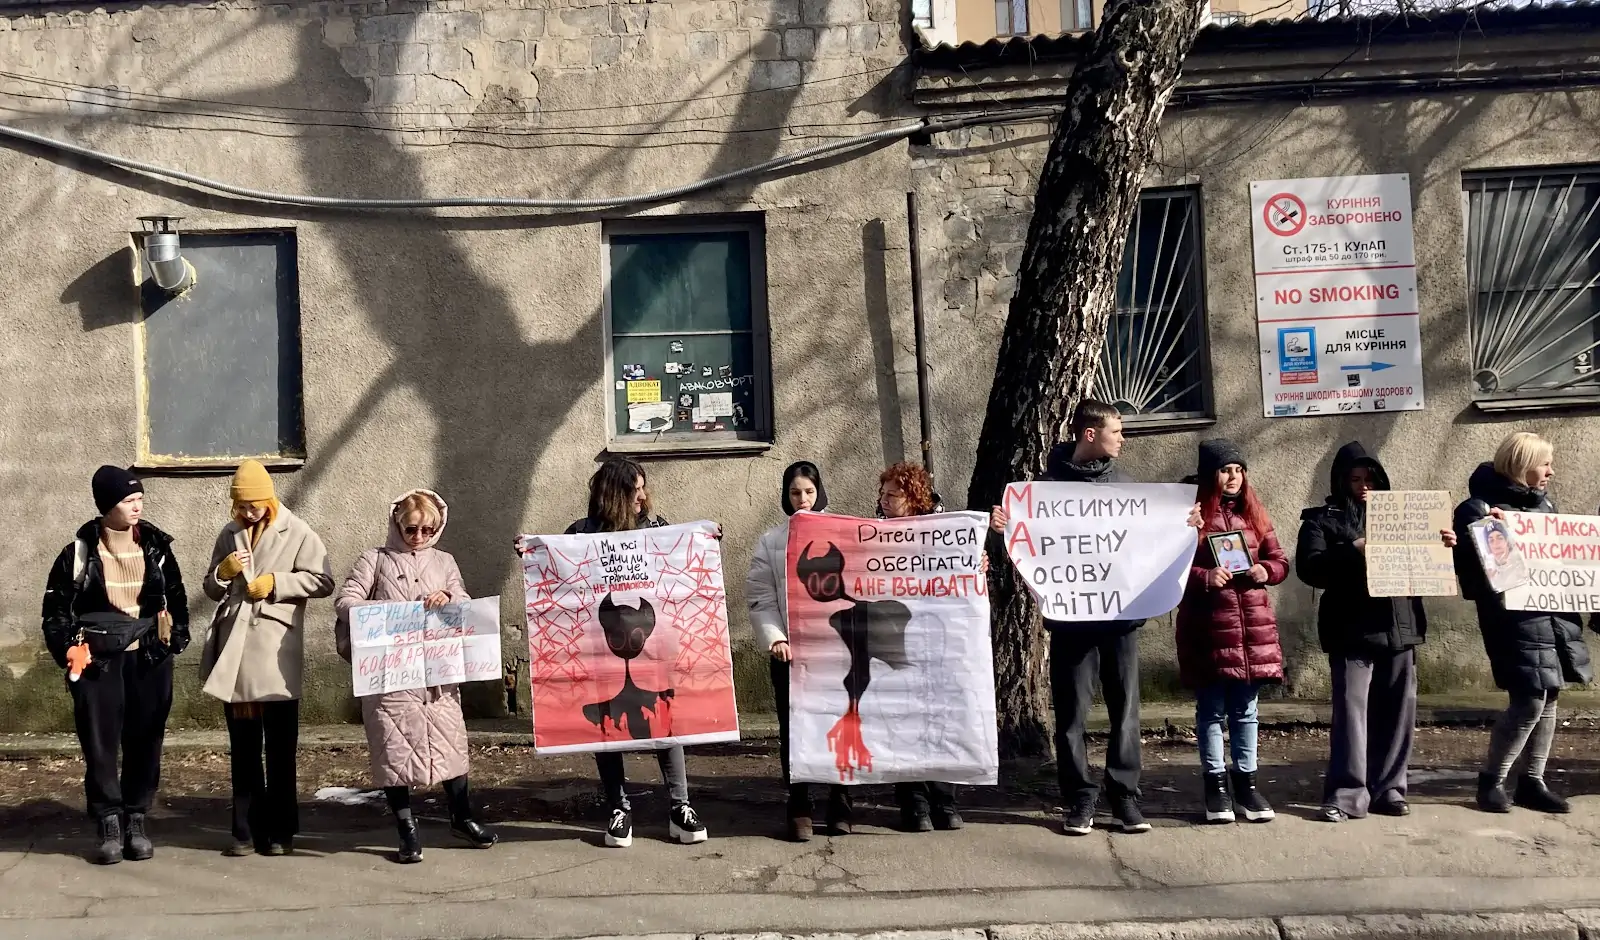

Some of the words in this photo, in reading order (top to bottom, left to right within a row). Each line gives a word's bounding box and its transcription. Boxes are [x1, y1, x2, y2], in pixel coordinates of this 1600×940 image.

[1327, 197, 1380, 210] КУРІННЯ
[1308, 210, 1402, 226] ЗАБОРОНЕНО
[1283, 242, 1339, 255] Ст.175-1
[1345, 240, 1386, 251] КУпАП
[1285, 255, 1313, 264] штраф
[1315, 254, 1328, 262] від
[1329, 253, 1339, 261] 50
[1354, 252, 1369, 260] 170
[1274, 289, 1302, 305] NO
[1309, 284, 1400, 304] SMOKING
[1345, 328, 1385, 340] МІСЦЕ
[1325, 342, 1351, 354] ДЛЯ
[1355, 340, 1407, 351] КУРІННЯ
[1275, 390, 1304, 402] КУРІННЯ
[1306, 389, 1341, 401] ШКОДИТЬ
[1343, 387, 1374, 398] ВАШОМУ
[1371, 493, 1395, 502] ХТО
[1370, 503, 1399, 512] КРОВ
[1369, 513, 1399, 522] ТОГО
[1403, 512, 1429, 521] КРОВ
[1514, 513, 1536, 536] ЗА
[1370, 533, 1406, 542] РУКОЮ
[1515, 542, 1600, 560] МАКСИМУ
[1015, 558, 1112, 586] ОСОВУ
[1529, 568, 1596, 588] КОСОВУ
[593, 583, 607, 594] НЕ
[854, 576, 864, 597] А
[866, 577, 886, 596] НЕ
[892, 574, 987, 598] ВБИВАТИ
